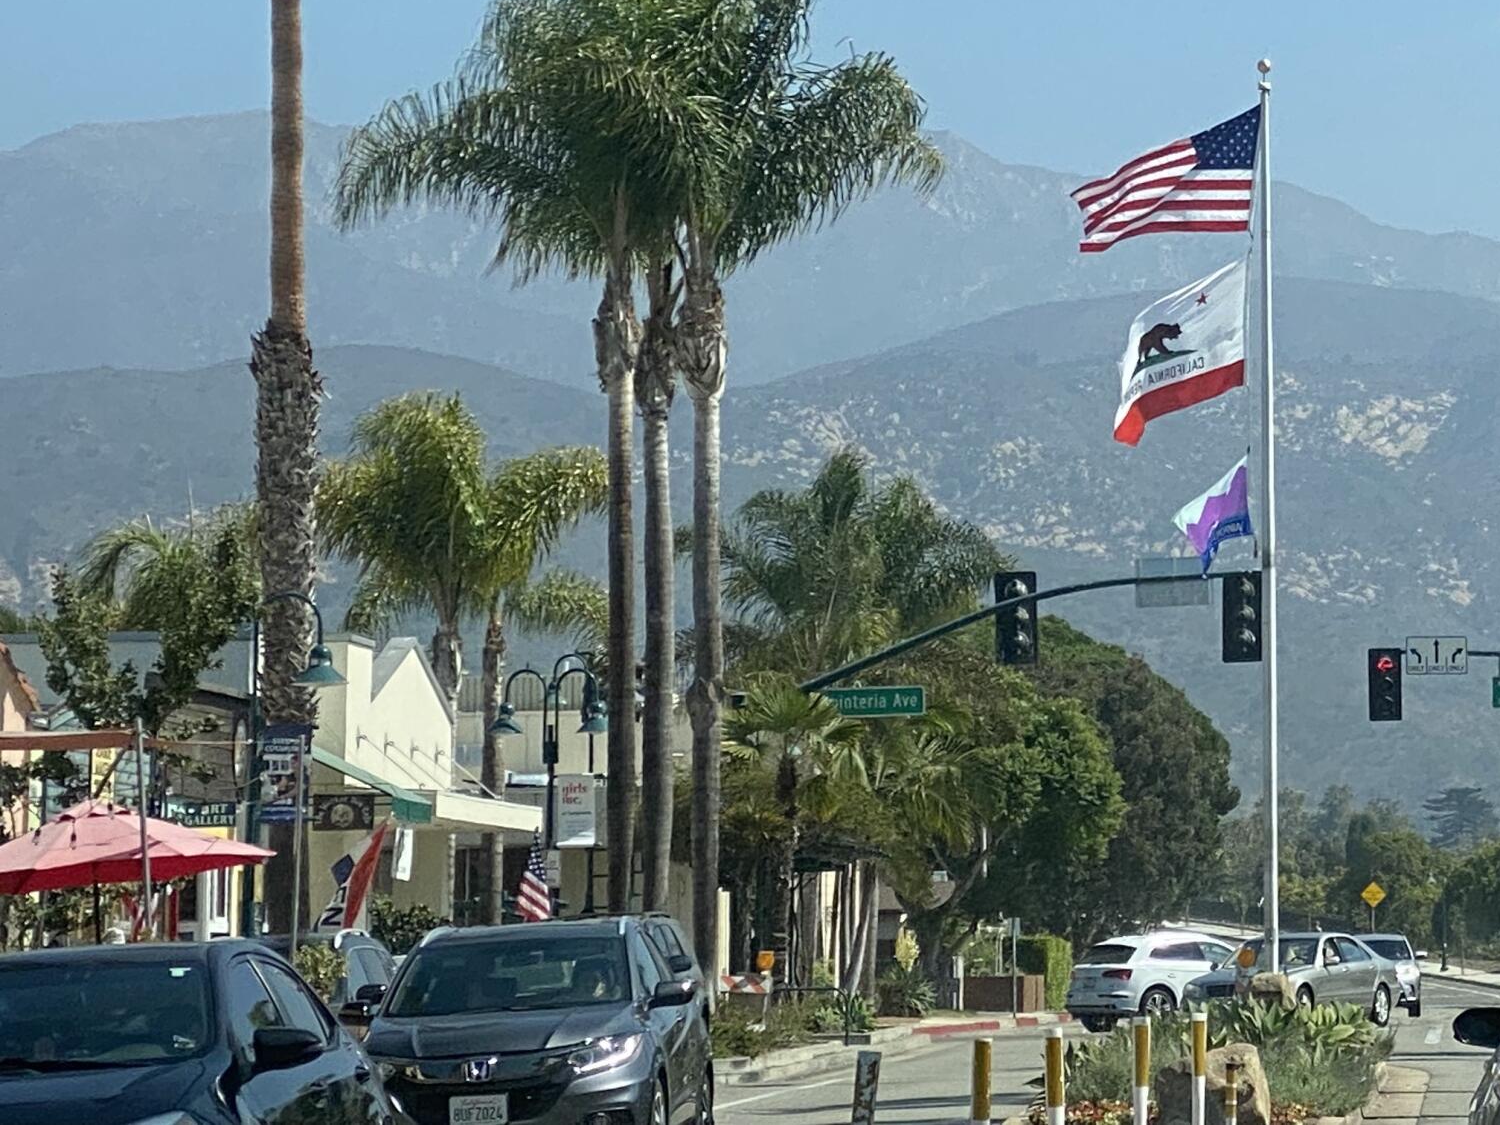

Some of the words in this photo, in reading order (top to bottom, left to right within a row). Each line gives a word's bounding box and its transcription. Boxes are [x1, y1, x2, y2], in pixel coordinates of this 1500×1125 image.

[892, 693, 918, 707] Ave
[562, 782, 587, 797] girls
[184, 815, 235, 825] GALLERY
